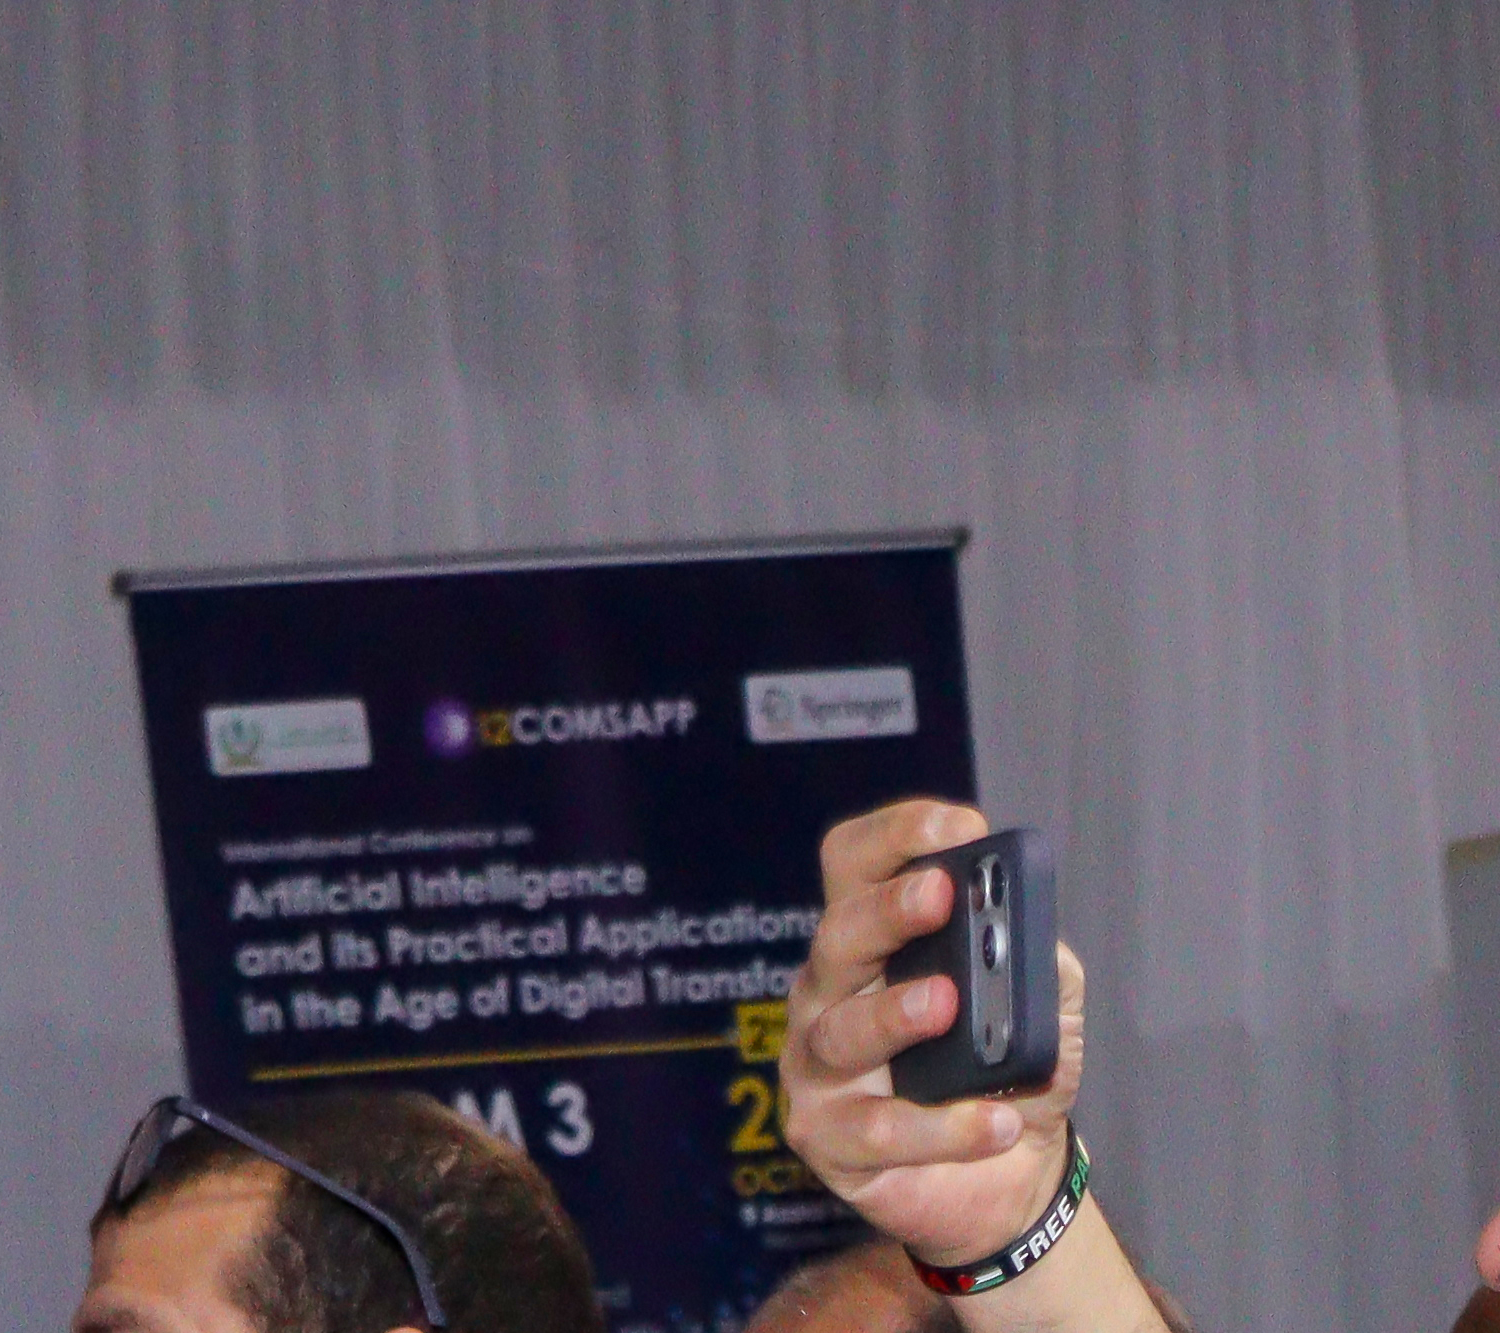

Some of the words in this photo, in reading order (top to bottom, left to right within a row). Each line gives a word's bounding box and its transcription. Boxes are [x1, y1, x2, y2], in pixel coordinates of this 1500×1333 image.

[231, 871, 402, 919] Artificial
[407, 863, 647, 911] Intelligence
[236, 933, 324, 977] and
[387, 917, 568, 964] Practical
[291, 990, 362, 1030] the
[374, 982, 459, 1031] Age
[469, 975, 509, 1018] of
[518, 968, 647, 1020] Digital
[546, 1080, 595, 1157] 3
[1010, 1194, 1075, 1273] FREE
